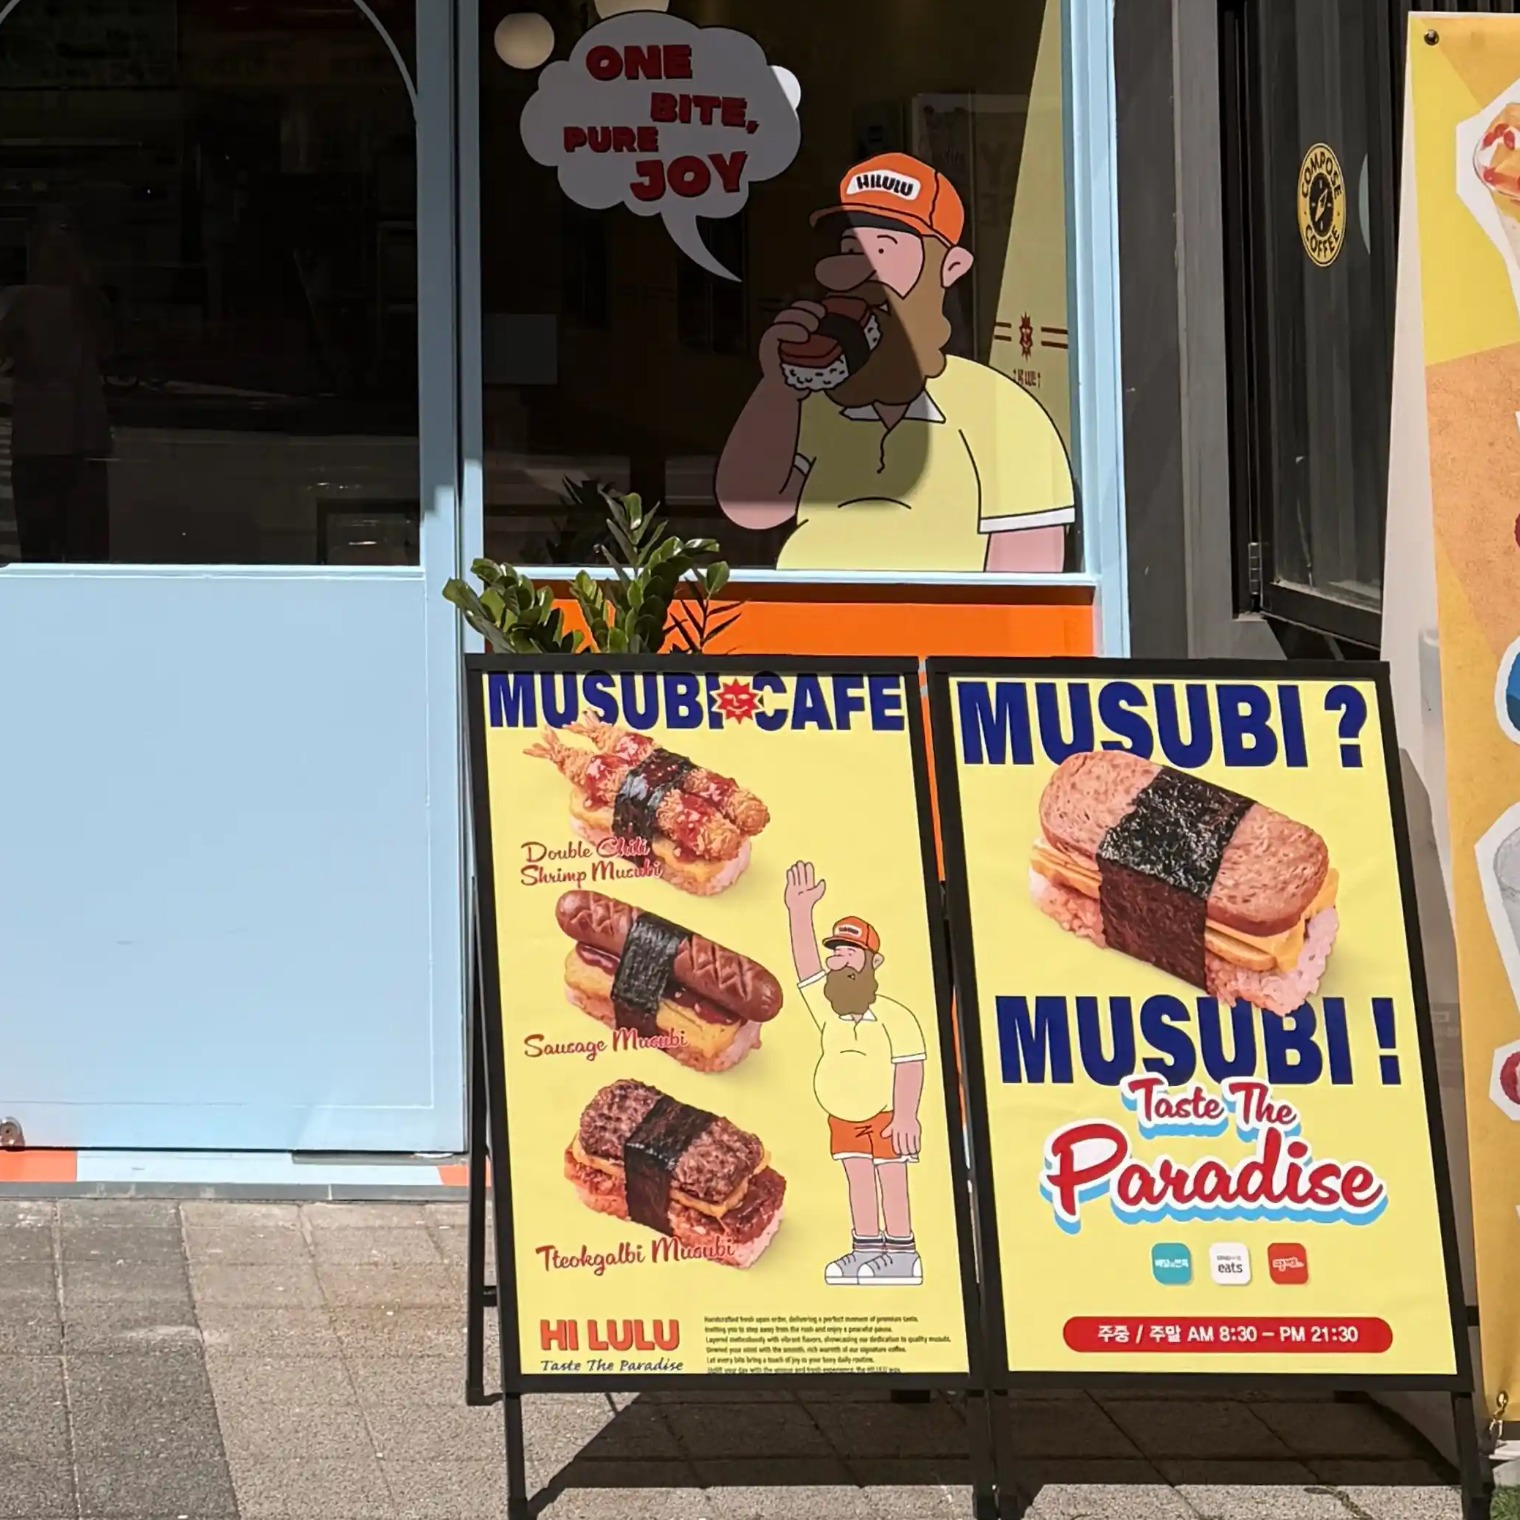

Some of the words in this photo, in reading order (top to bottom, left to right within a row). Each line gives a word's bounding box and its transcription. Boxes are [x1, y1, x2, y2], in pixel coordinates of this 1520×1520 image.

[585, 44, 693, 81] ONE
[650, 92, 760, 135] BITE,
[563, 126, 659, 153] PURE
[630, 151, 749, 202] JOY
[856, 174, 914, 196] HILULU
[1301, 151, 1343, 200] COMPOSE
[1304, 223, 1340, 259] COFFEE
[486, 670, 725, 729] MUSUBI
[752, 670, 907, 732] CAFE
[956, 681, 1307, 769] MUSUBI
[520, 840, 593, 863] Double
[595, 836, 651, 859] Chili
[520, 864, 587, 889] Shrimp
[591, 858, 664, 882] Musubi
[523, 1033, 608, 1062] Sausage
[612, 1027, 690, 1053] Musubi
[995, 995, 1353, 1086] MUSUBI
[1126, 1076, 1225, 1122] Taste
[1229, 1081, 1298, 1125] The
[1046, 1126, 1384, 1216] Paradise
[535, 1242, 645, 1277] Tteokgalbi
[651, 1235, 736, 1264] Musubi
[1217, 1262, 1243, 1273] eats
[539, 1319, 579, 1352] HI
[587, 1319, 681, 1352] LULU
[1097, 1325, 1130, 1344] 주중
[1149, 1325, 1182, 1344] 주말
[1187, 1326, 1215, 1343] AM
[1219, 1326, 1258, 1343] 8:30
[1280, 1326, 1306, 1343] PM
[1311, 1326, 1359, 1343] 21:30
[540, 1360, 582, 1372] Taste
[586, 1357, 614, 1372] The
[619, 1357, 684, 1372] Paradise
